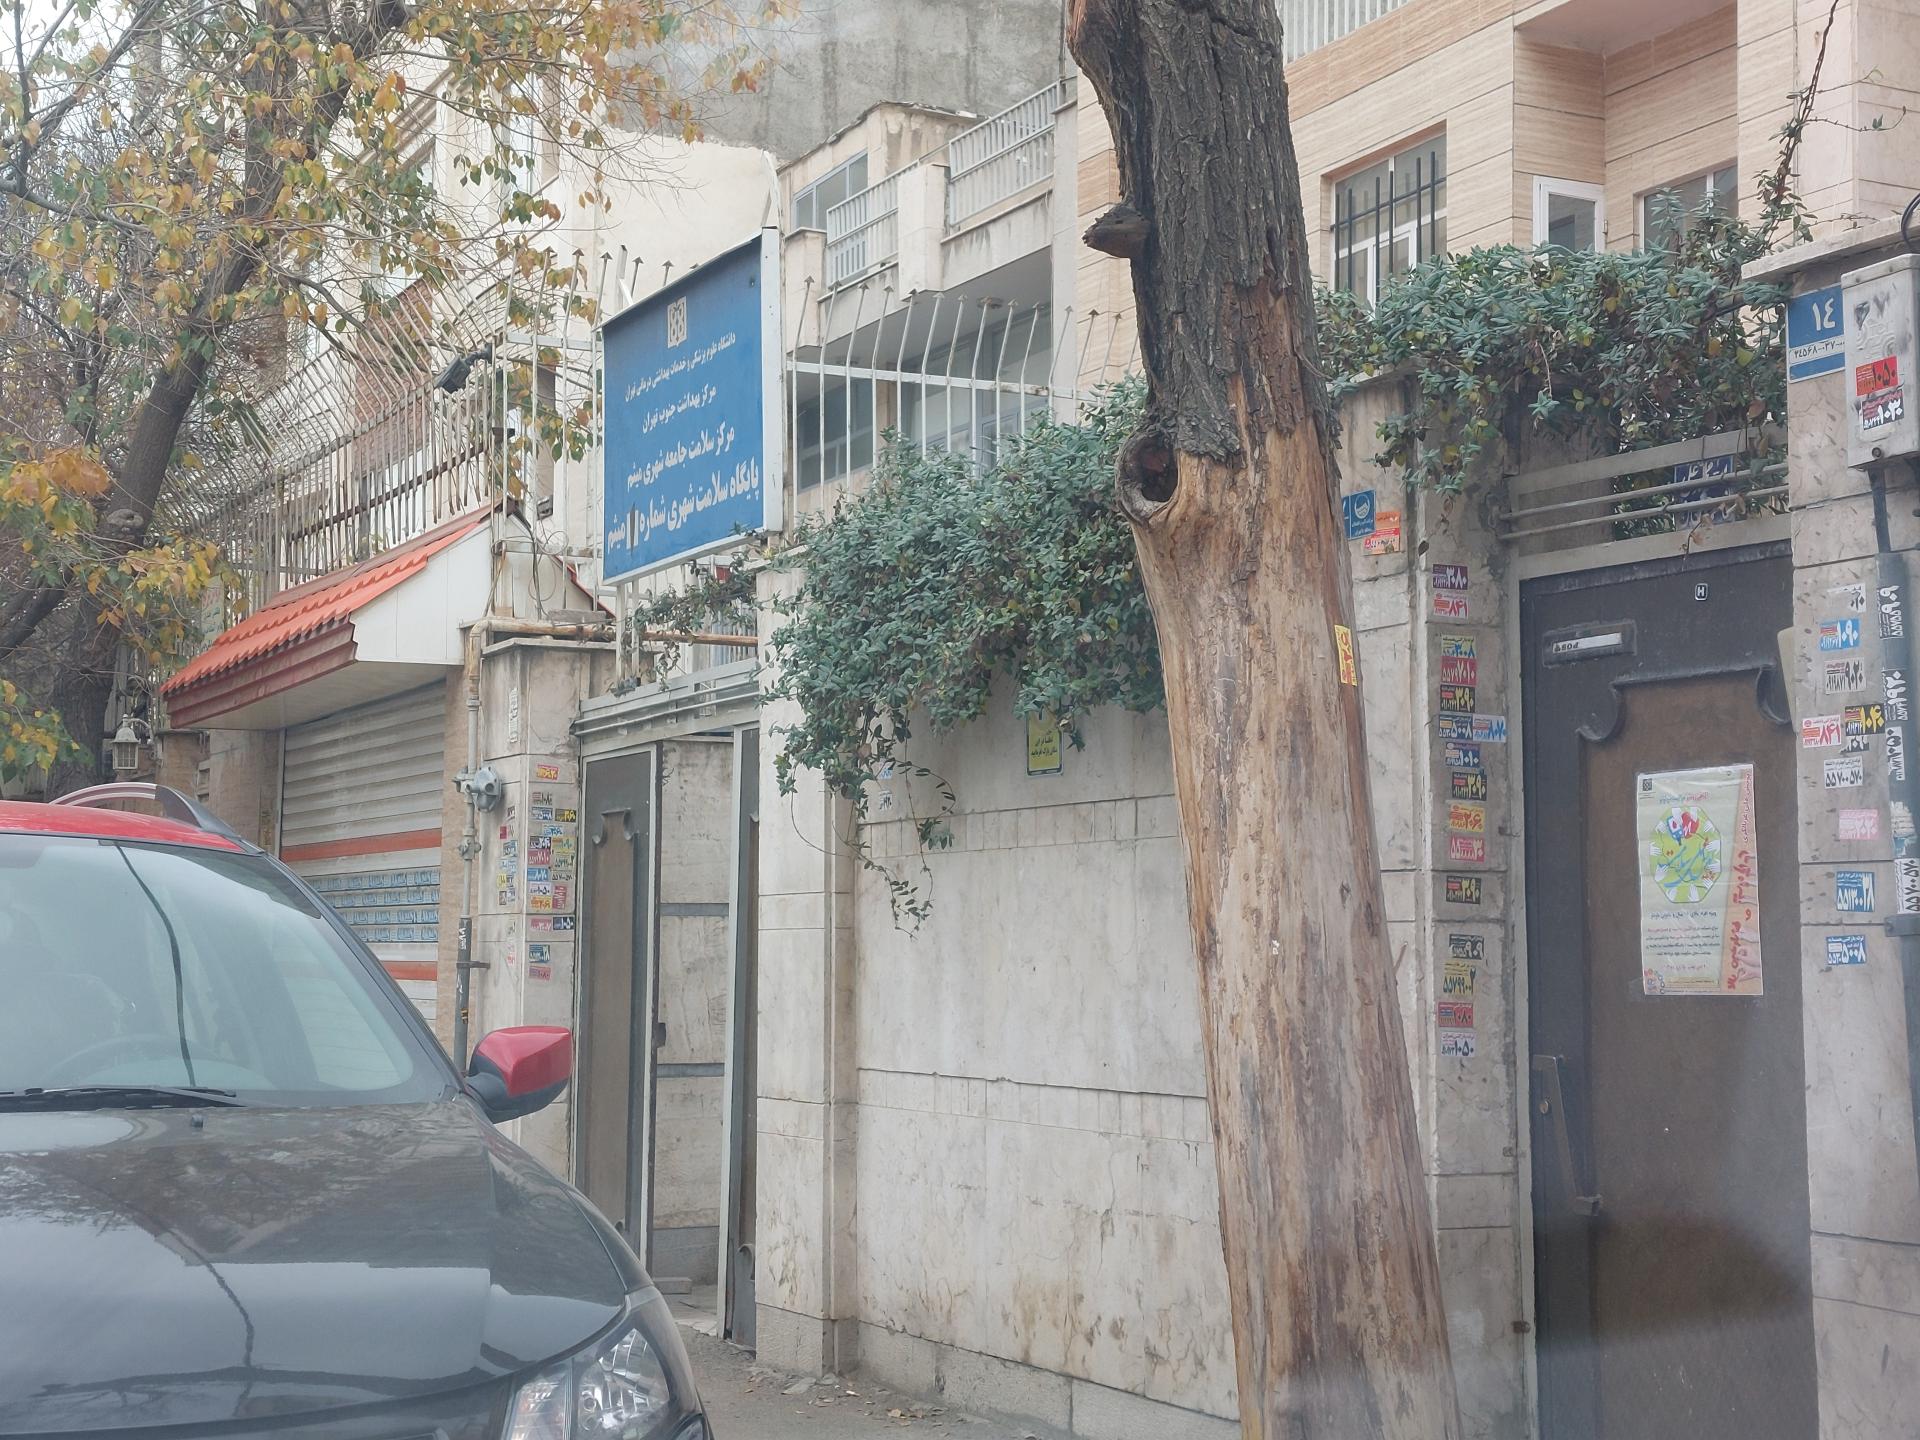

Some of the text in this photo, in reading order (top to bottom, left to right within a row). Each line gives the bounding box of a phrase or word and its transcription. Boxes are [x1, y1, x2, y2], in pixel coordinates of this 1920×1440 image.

[707, 342, 718, 360] علوم
[718, 332, 736, 351] دانشگاه
[670, 356, 686, 375] خدمات
[691, 344, 706, 369] پزشکی
[636, 377, 652, 396] درمانی
[653, 367, 671, 388] بهداشتی
[625, 382, 637, 402] تهران
[642, 383, 716, 434] مرکز بهداشت جنوب تهران
[627, 421, 735, 493] مرکز سلامت جامعه شهری میثم
[695, 470, 729, 511] سلامت
[729, 456, 760, 501] پایگاه
[640, 496, 667, 541] شماره
[667, 483, 695, 531] شهری
[607, 514, 626, 554] میثم
[1697, 587, 1705, 597] H
